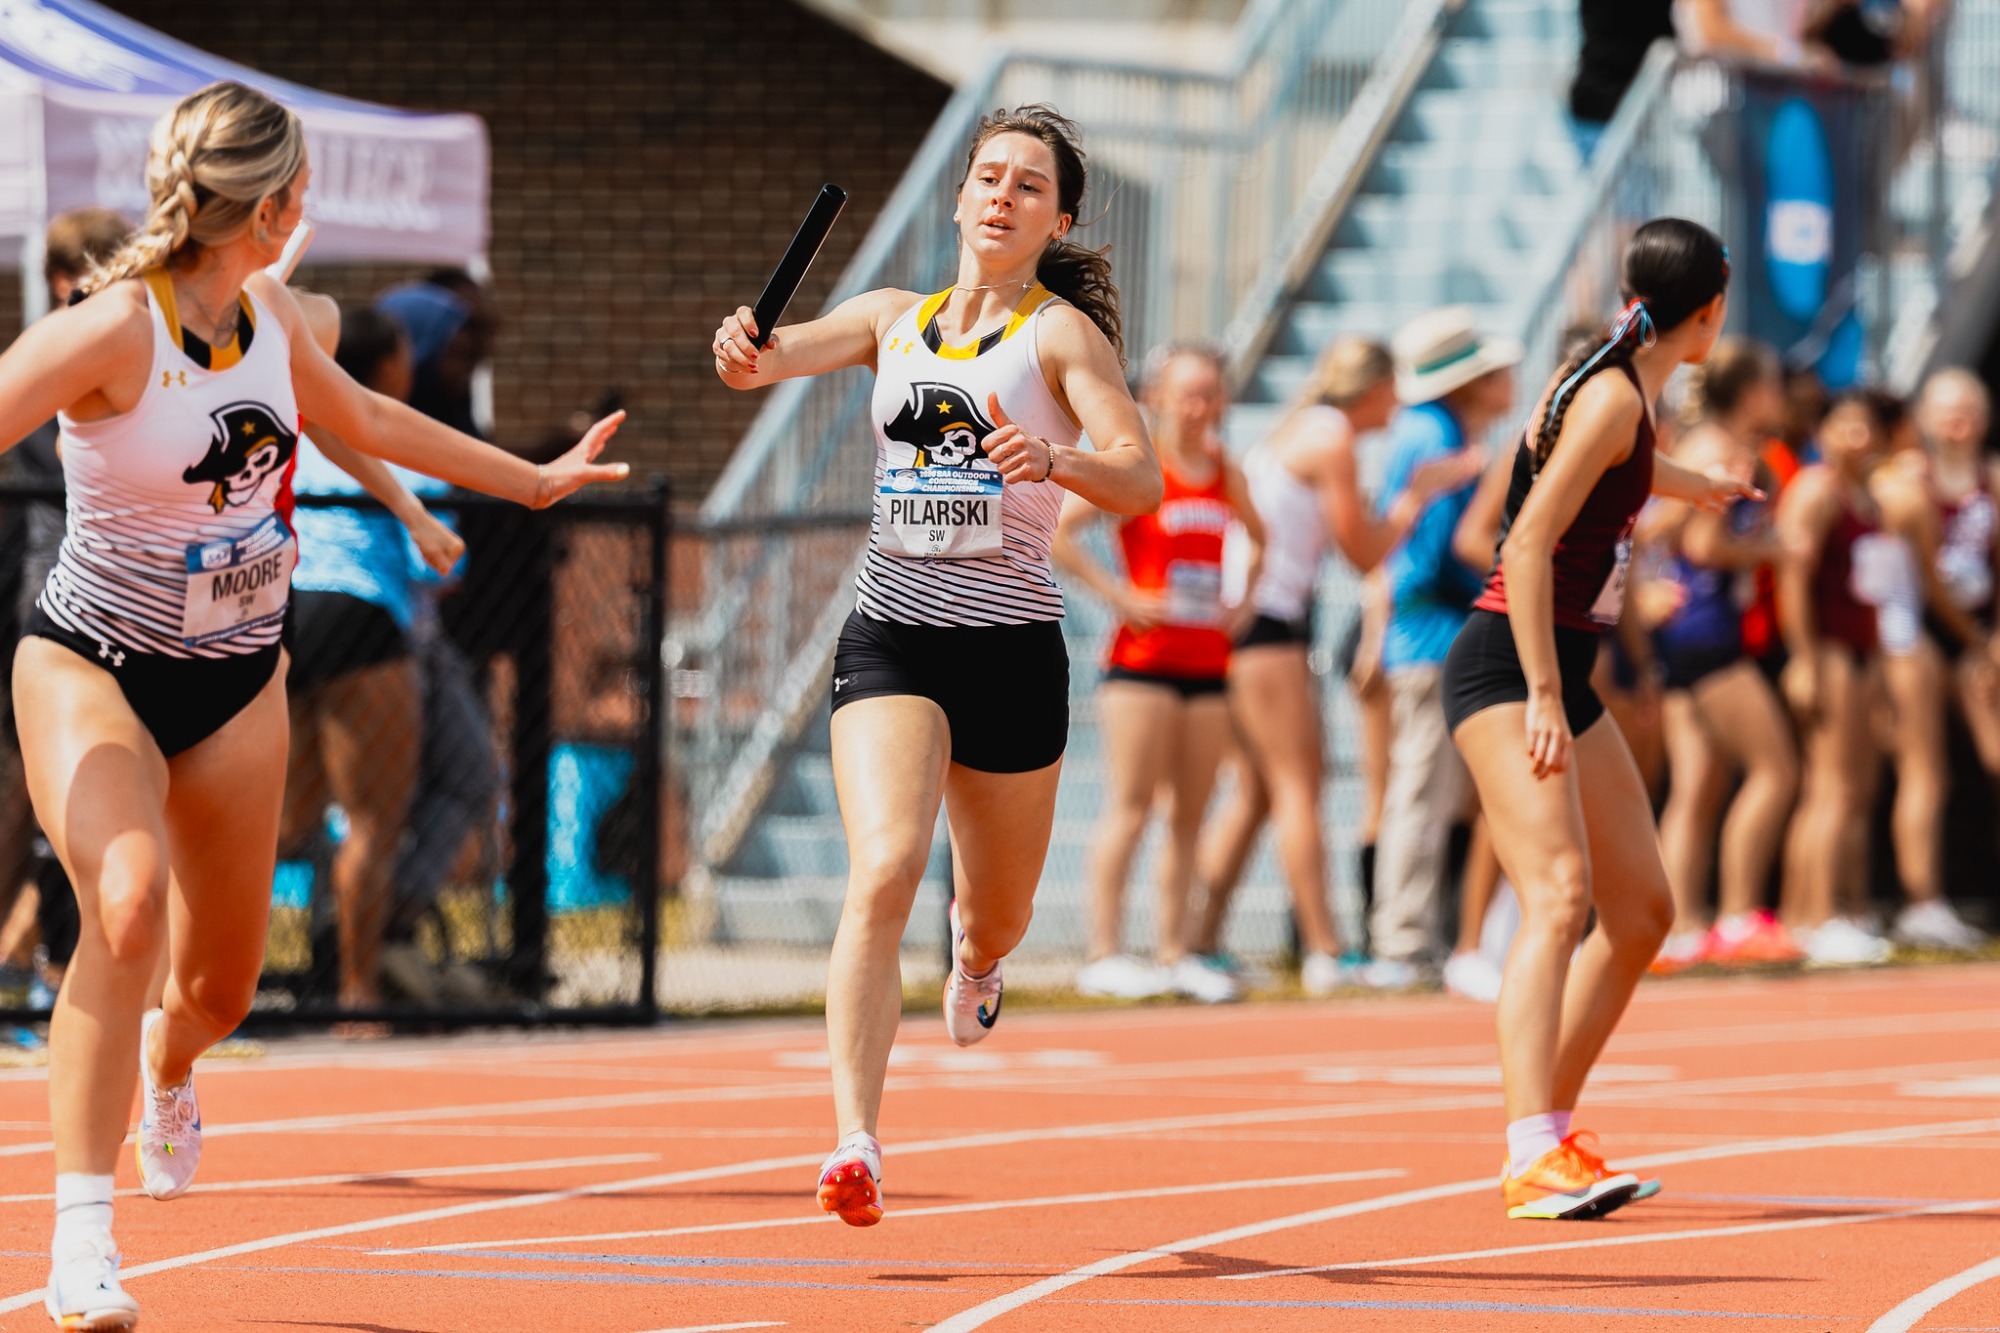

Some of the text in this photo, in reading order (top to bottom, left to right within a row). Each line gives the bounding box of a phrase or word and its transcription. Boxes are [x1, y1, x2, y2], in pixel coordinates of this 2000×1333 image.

[952, 472, 990, 480] OUTDOOR
[922, 485, 985, 493] CHAMPIONSHIPS
[890, 499, 988, 526] PILARSKI
[929, 530, 945, 541] SW
[213, 552, 282, 601] MOORE
